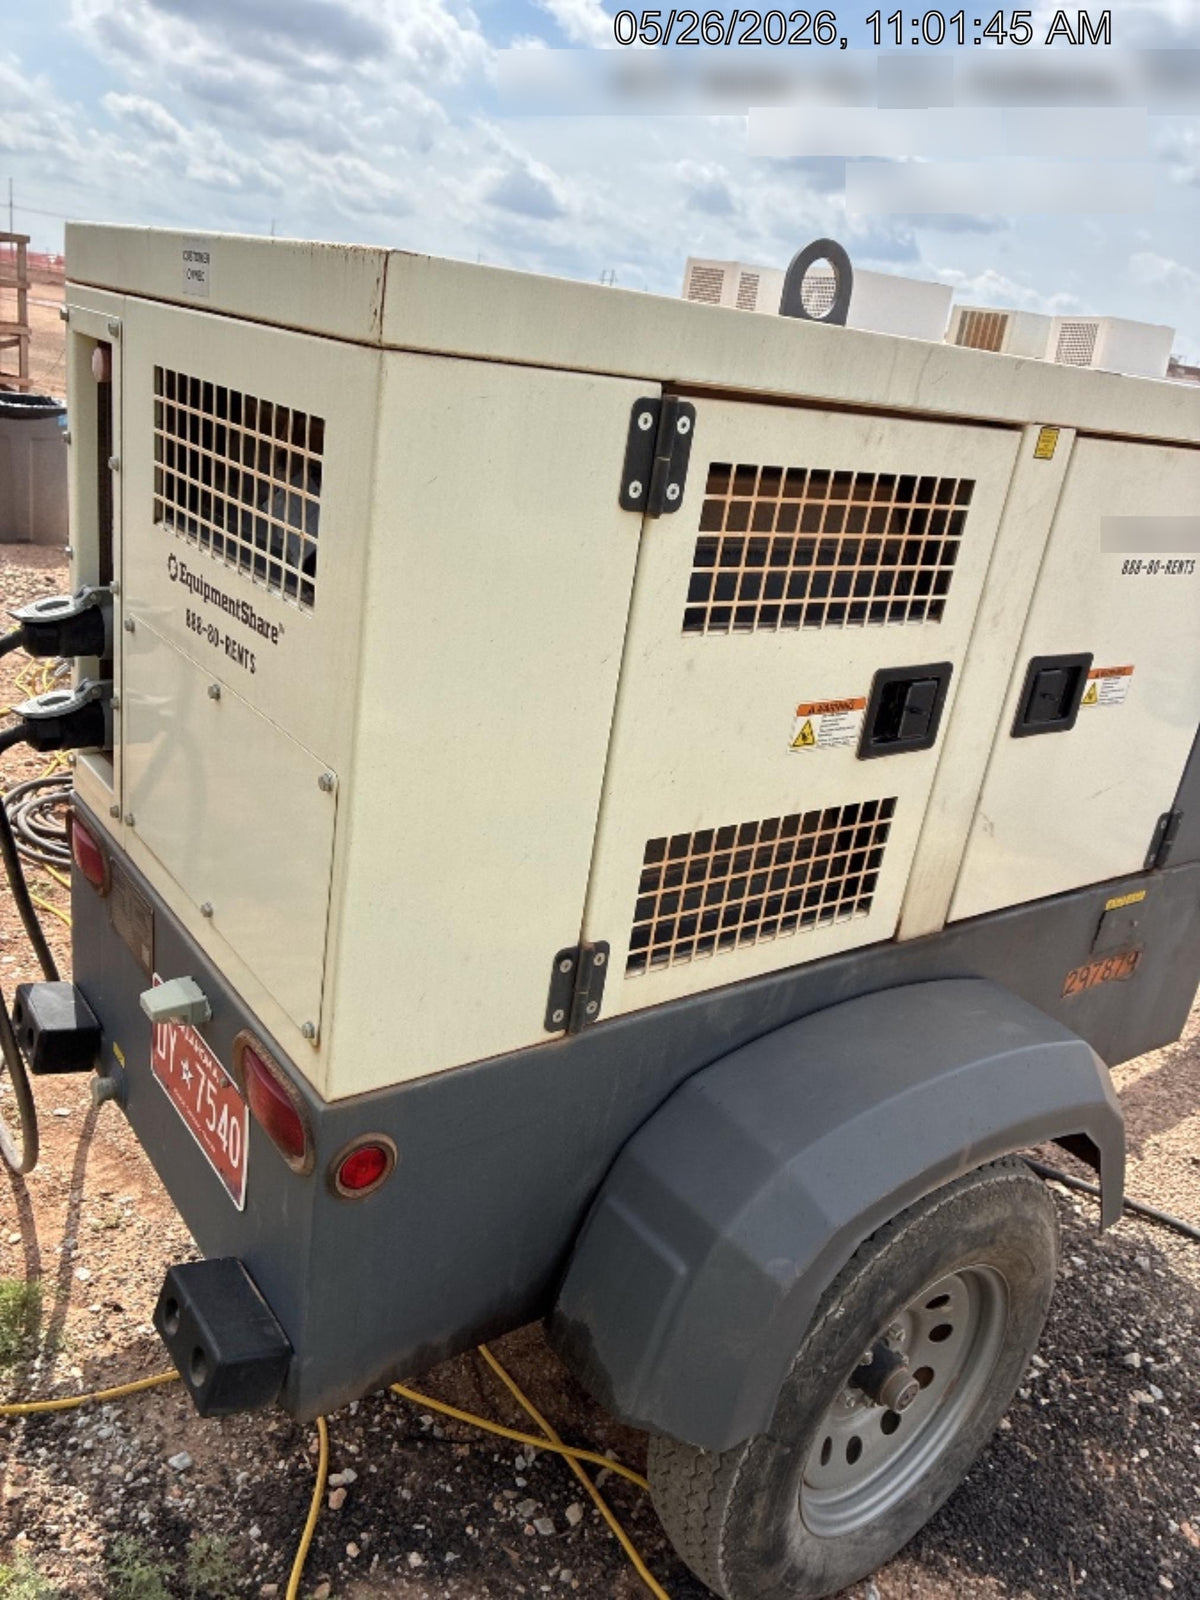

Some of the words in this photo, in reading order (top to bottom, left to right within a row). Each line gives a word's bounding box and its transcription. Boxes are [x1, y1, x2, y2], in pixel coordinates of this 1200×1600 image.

[1121, 559, 1196, 575] 888-80-RENTS
[185, 607, 257, 675] 888-80-RENTS
[177, 1024, 219, 1083] LAHOMA
[195, 1062, 241, 1168] 7540
